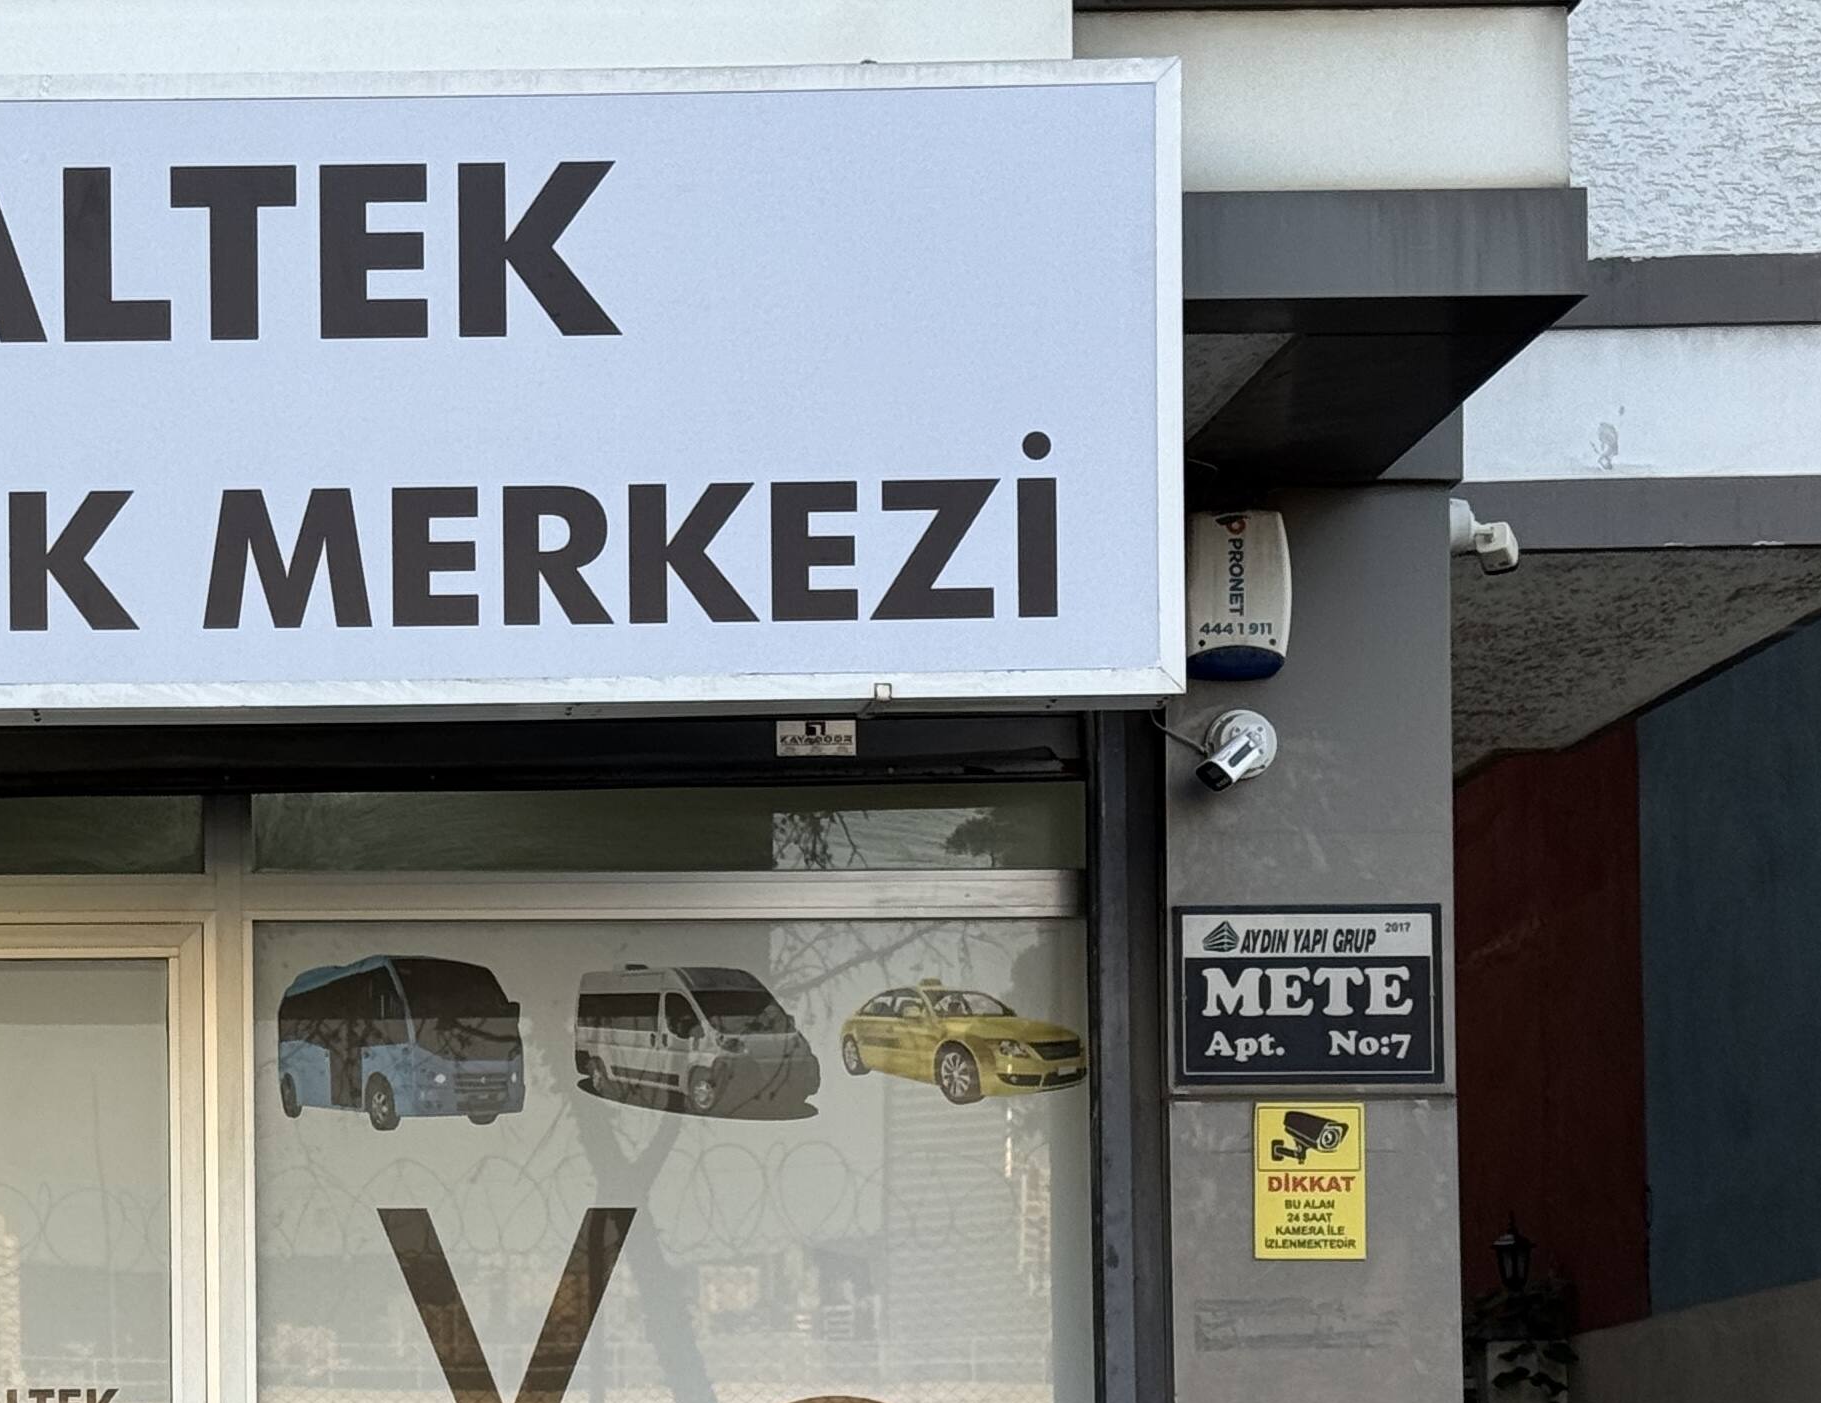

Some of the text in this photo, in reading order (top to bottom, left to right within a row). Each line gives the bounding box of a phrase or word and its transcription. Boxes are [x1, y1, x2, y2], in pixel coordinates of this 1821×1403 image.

[203, 431, 1059, 630] MERKEZİ
[1228, 538, 1244, 616] PRONET
[1200, 622, 1233, 635] 444
[1249, 622, 1273, 635] 911
[1384, 922, 1411, 933] 2017
[1240, 928, 1377, 954] AYDIN YAPI GRUP
[1202, 966, 1413, 1017] METE
[1204, 1030, 1412, 1062] Apt. No:7
[1268, 1173, 1356, 1193] DİKKAT
[1284, 1199, 1335, 1210] BU ALAN
[1287, 1212, 1333, 1223] 24 SAAT
[1275, 1224, 1345, 1236] KAMERA İLE
[1265, 1237, 1356, 1249] İZLENMEKTEDİR
